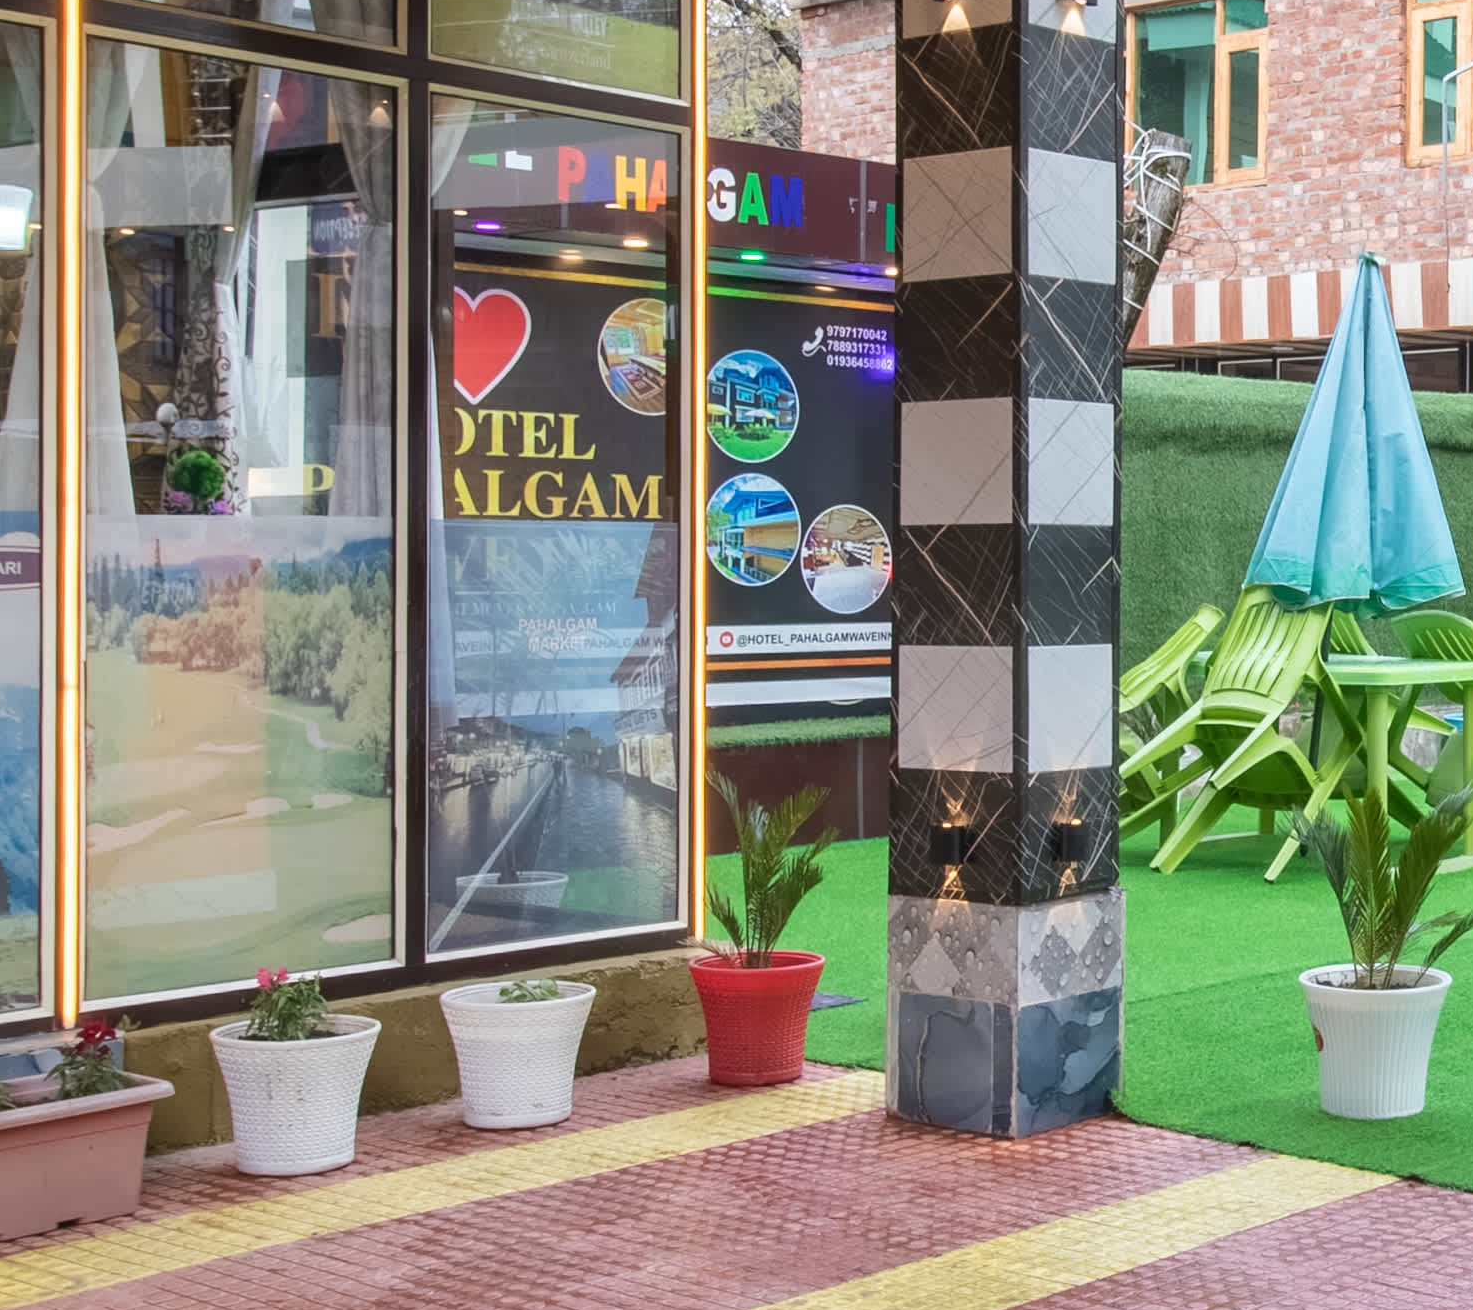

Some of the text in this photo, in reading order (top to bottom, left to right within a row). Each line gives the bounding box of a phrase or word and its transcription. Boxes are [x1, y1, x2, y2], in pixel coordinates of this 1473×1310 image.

[826, 324, 888, 342] 9797170042
[826, 339, 887, 356] 7889317331
[826, 354, 894, 371] 01936458862
[518, 617, 598, 636] PAHALGAM
[528, 634, 586, 652] MARKET
